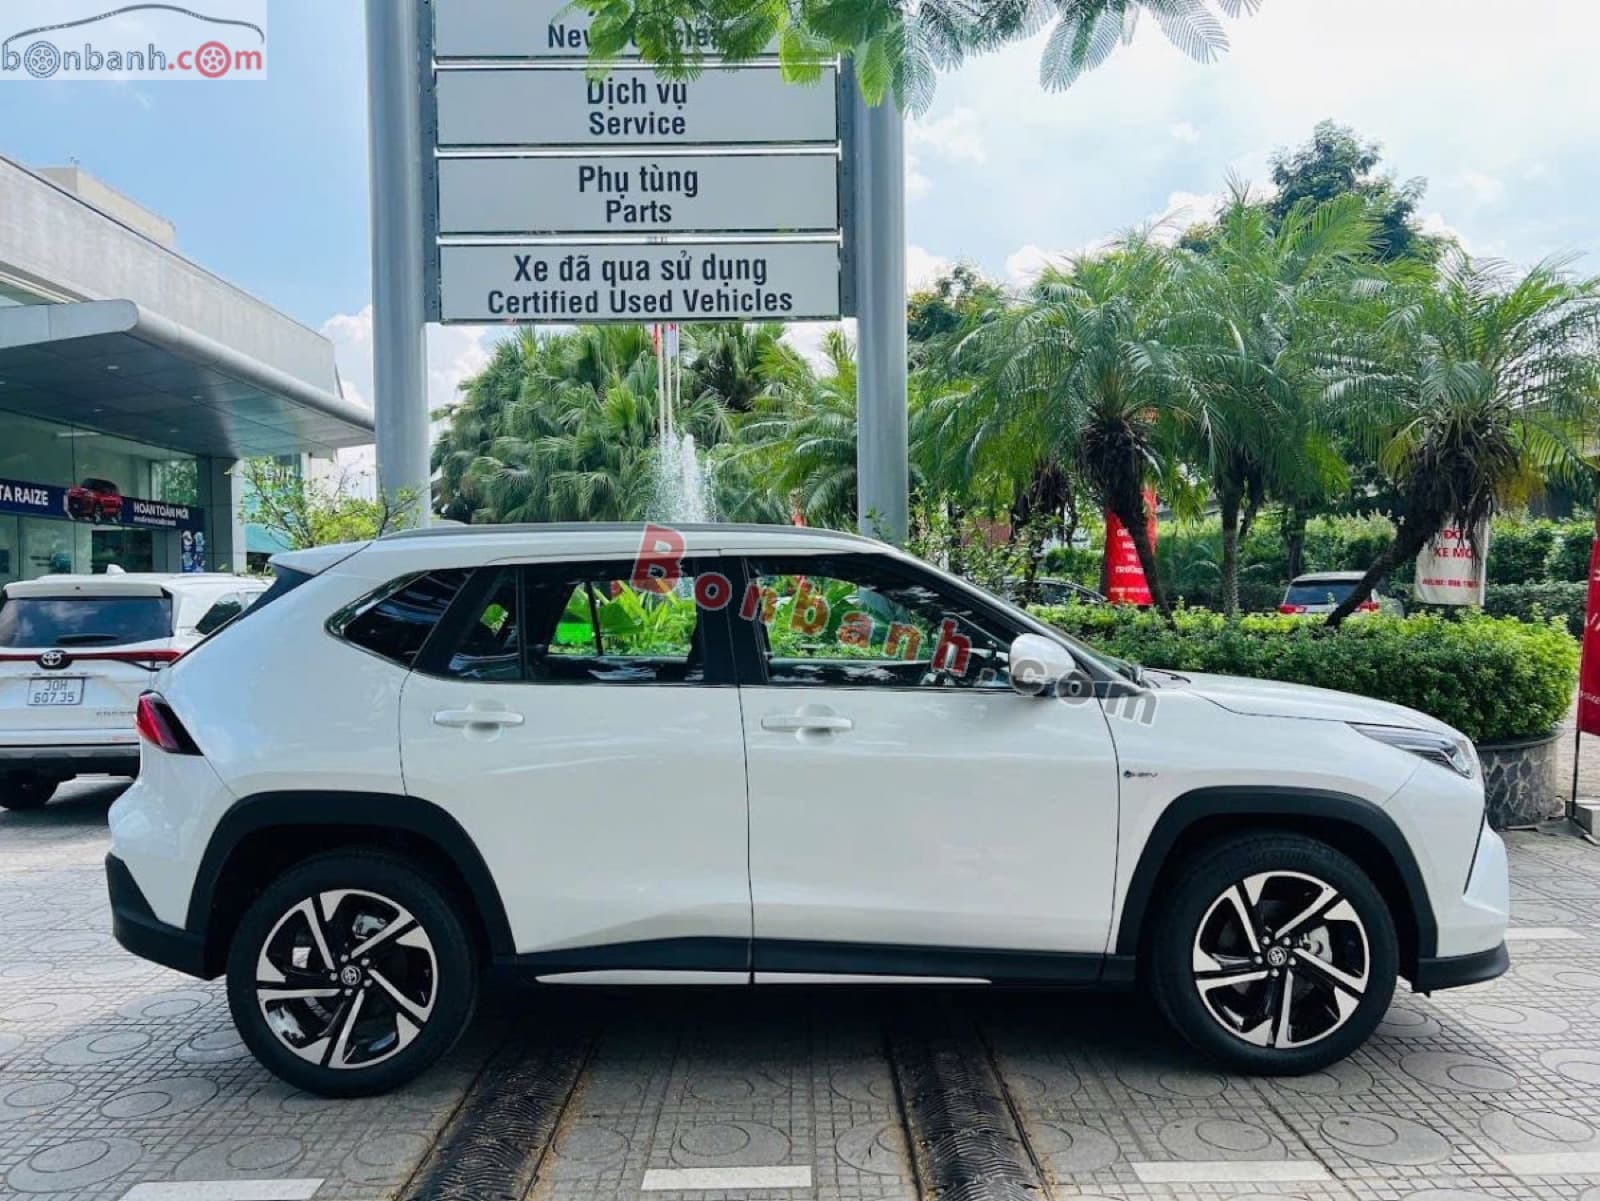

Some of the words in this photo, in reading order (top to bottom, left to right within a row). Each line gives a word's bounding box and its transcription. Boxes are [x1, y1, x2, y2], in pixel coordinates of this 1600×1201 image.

[587, 78, 646, 110] Dịch
[656, 82, 687, 110] vụ
[589, 111, 686, 136] Service
[579, 165, 629, 200] Phụ
[640, 163, 699, 198] tùng
[606, 201, 672, 224] Parts
[513, 255, 549, 282] Xe
[559, 254, 591, 282] đã
[602, 259, 650, 287] qua
[661, 249, 692, 281] sử
[702, 252, 767, 287] dụng
[487, 289, 599, 315] Certified
[609, 289, 674, 314] Used
[683, 288, 793, 313] Vehicles
[14, 487, 49, 506] RAIZE
